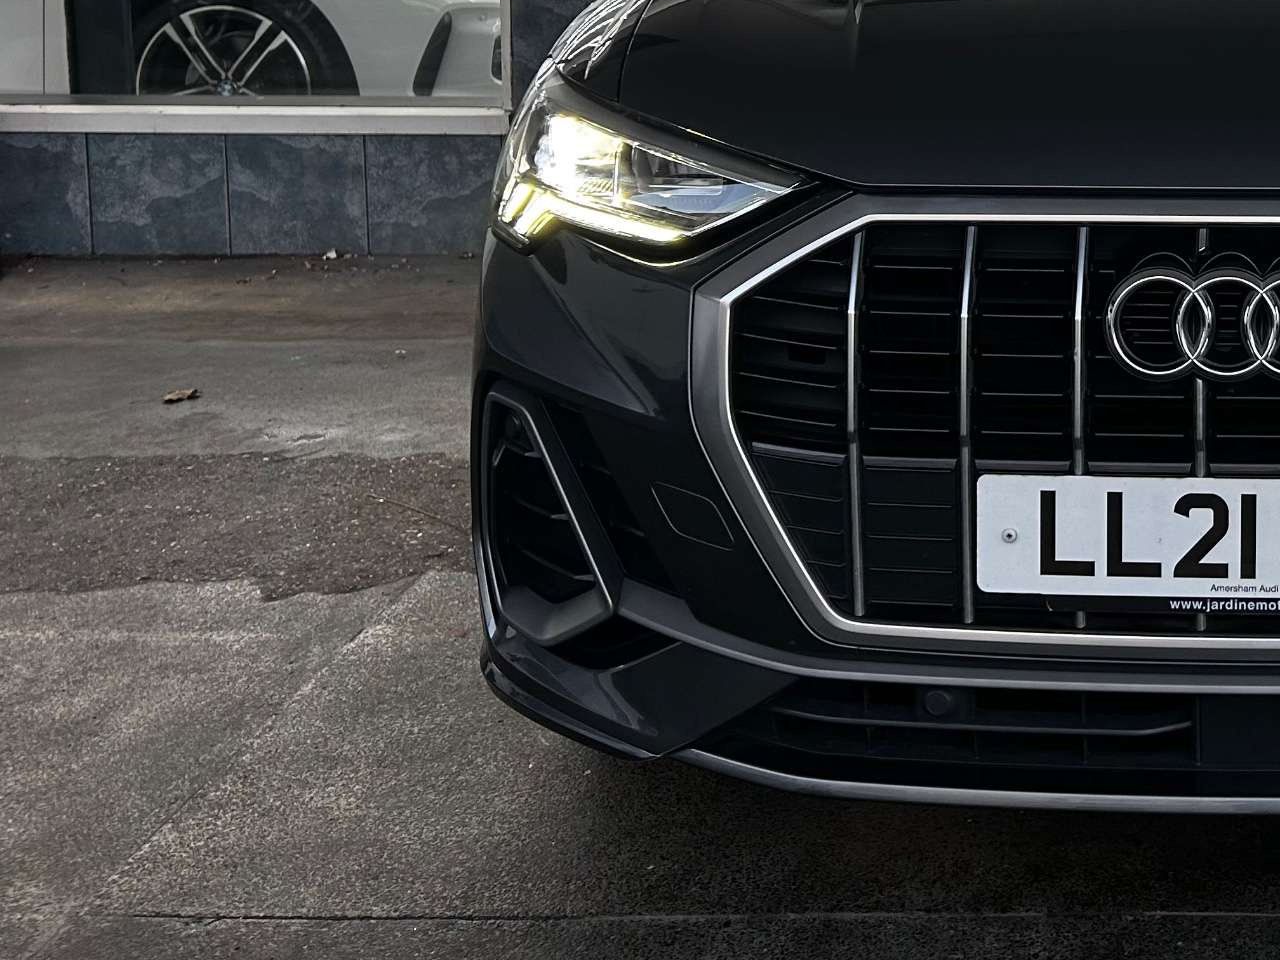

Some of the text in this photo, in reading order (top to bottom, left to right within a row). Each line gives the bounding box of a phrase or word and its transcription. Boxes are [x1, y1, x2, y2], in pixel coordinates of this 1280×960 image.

[1040, 490, 1257, 580] LL21
[1210, 584, 1257, 593] Amersham
[1259, 584, 1279, 593] Audi
